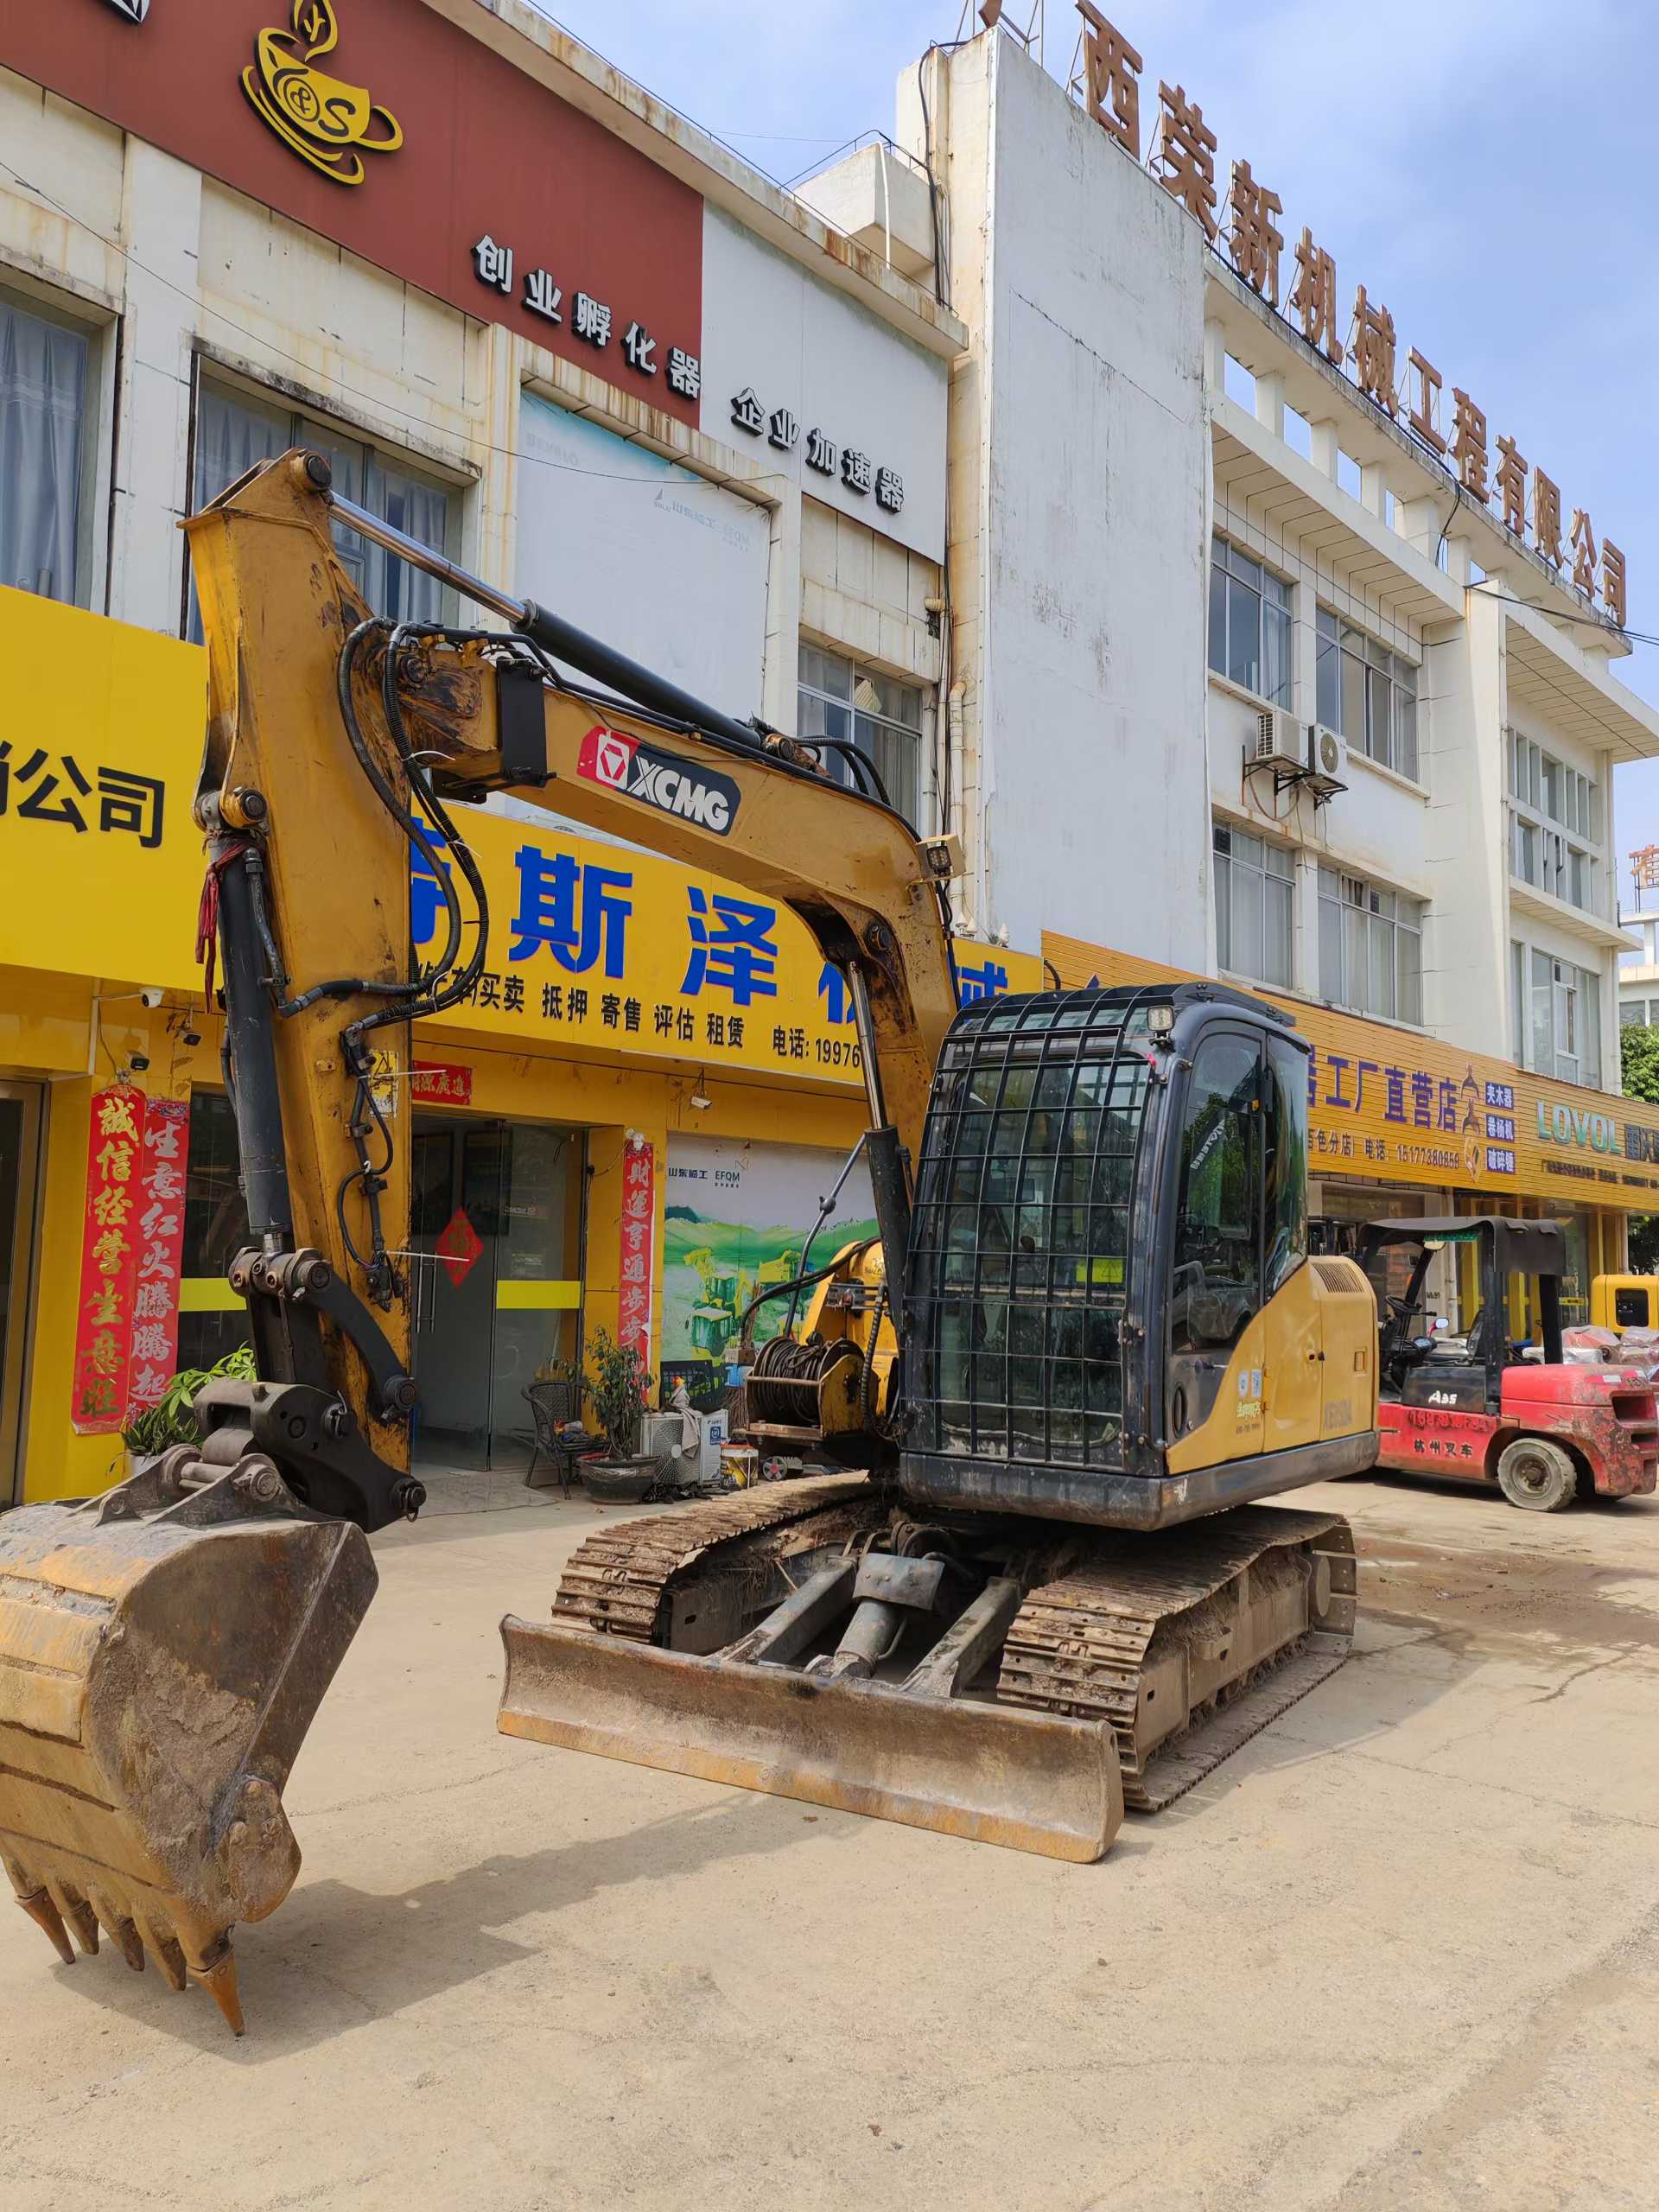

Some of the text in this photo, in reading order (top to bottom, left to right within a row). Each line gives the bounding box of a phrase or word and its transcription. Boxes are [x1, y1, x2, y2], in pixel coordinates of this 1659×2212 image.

[473, 234, 701, 401] 创业孵化器
[978, 0, 1627, 627] 西荣新机械工程有限公司
[731, 386, 905, 514] 企业加速器
[625, 755, 730, 830] XCMG
[542, 982, 588, 1024] 抵押
[601, 993, 642, 1033] 寄售
[654, 1003, 695, 1042] 评估
[706, 1012, 745, 1048] 租赁
[715, 1170, 741, 1182] EFQM
[1535, 1099, 1622, 1154] LOVOL
[621, 1160, 651, 1376] 財運亨通步步
